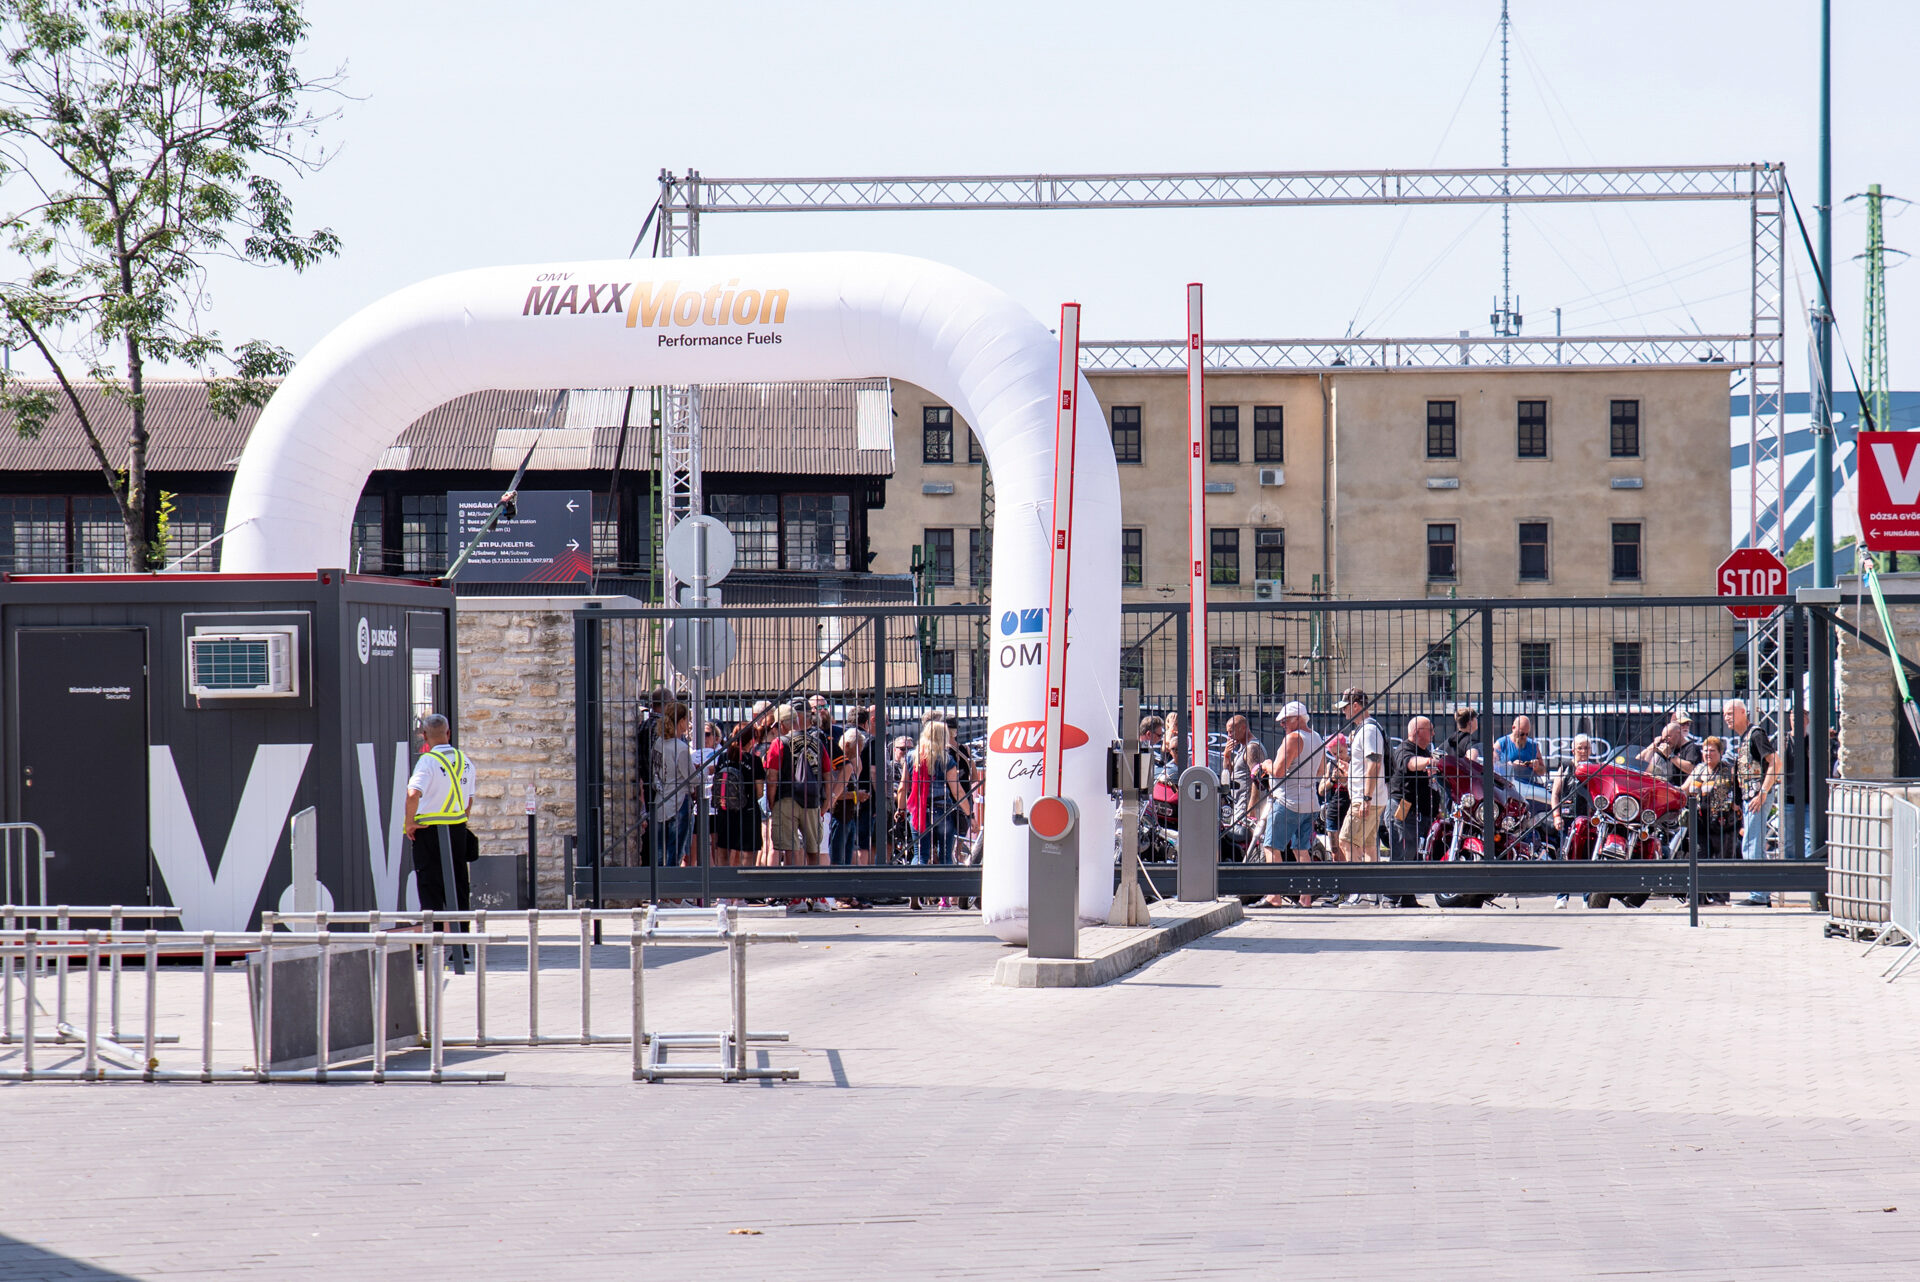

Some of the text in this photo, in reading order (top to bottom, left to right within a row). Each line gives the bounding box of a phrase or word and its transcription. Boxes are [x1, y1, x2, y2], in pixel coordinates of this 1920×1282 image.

[536, 272, 574, 282] OMV
[658, 332, 782, 347] Performance Fuels
[1870, 512, 1898, 521] DÓZSA
[1723, 568, 1782, 596] STOP
[371, 625, 397, 647] PUSKÁS
[102, 686, 131, 694] szolgálat
